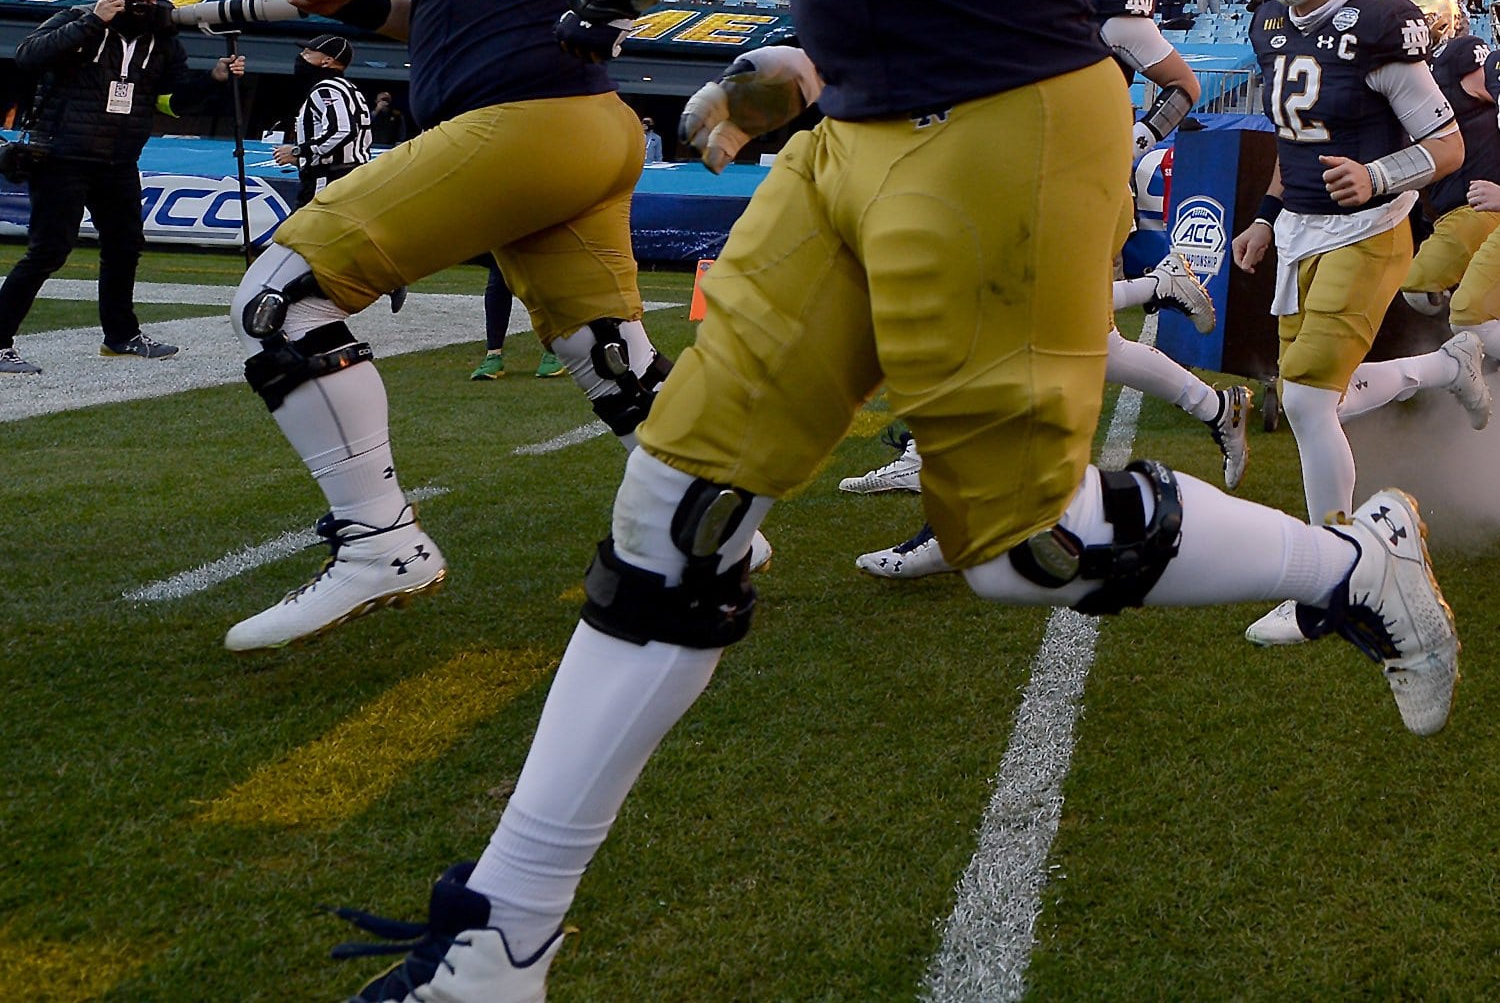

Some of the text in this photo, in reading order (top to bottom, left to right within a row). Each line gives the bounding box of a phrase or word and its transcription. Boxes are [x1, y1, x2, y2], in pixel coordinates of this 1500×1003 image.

[1337, 33, 1358, 61] C
[1271, 54, 1332, 143] 12
[1178, 222, 1217, 244] ACC
